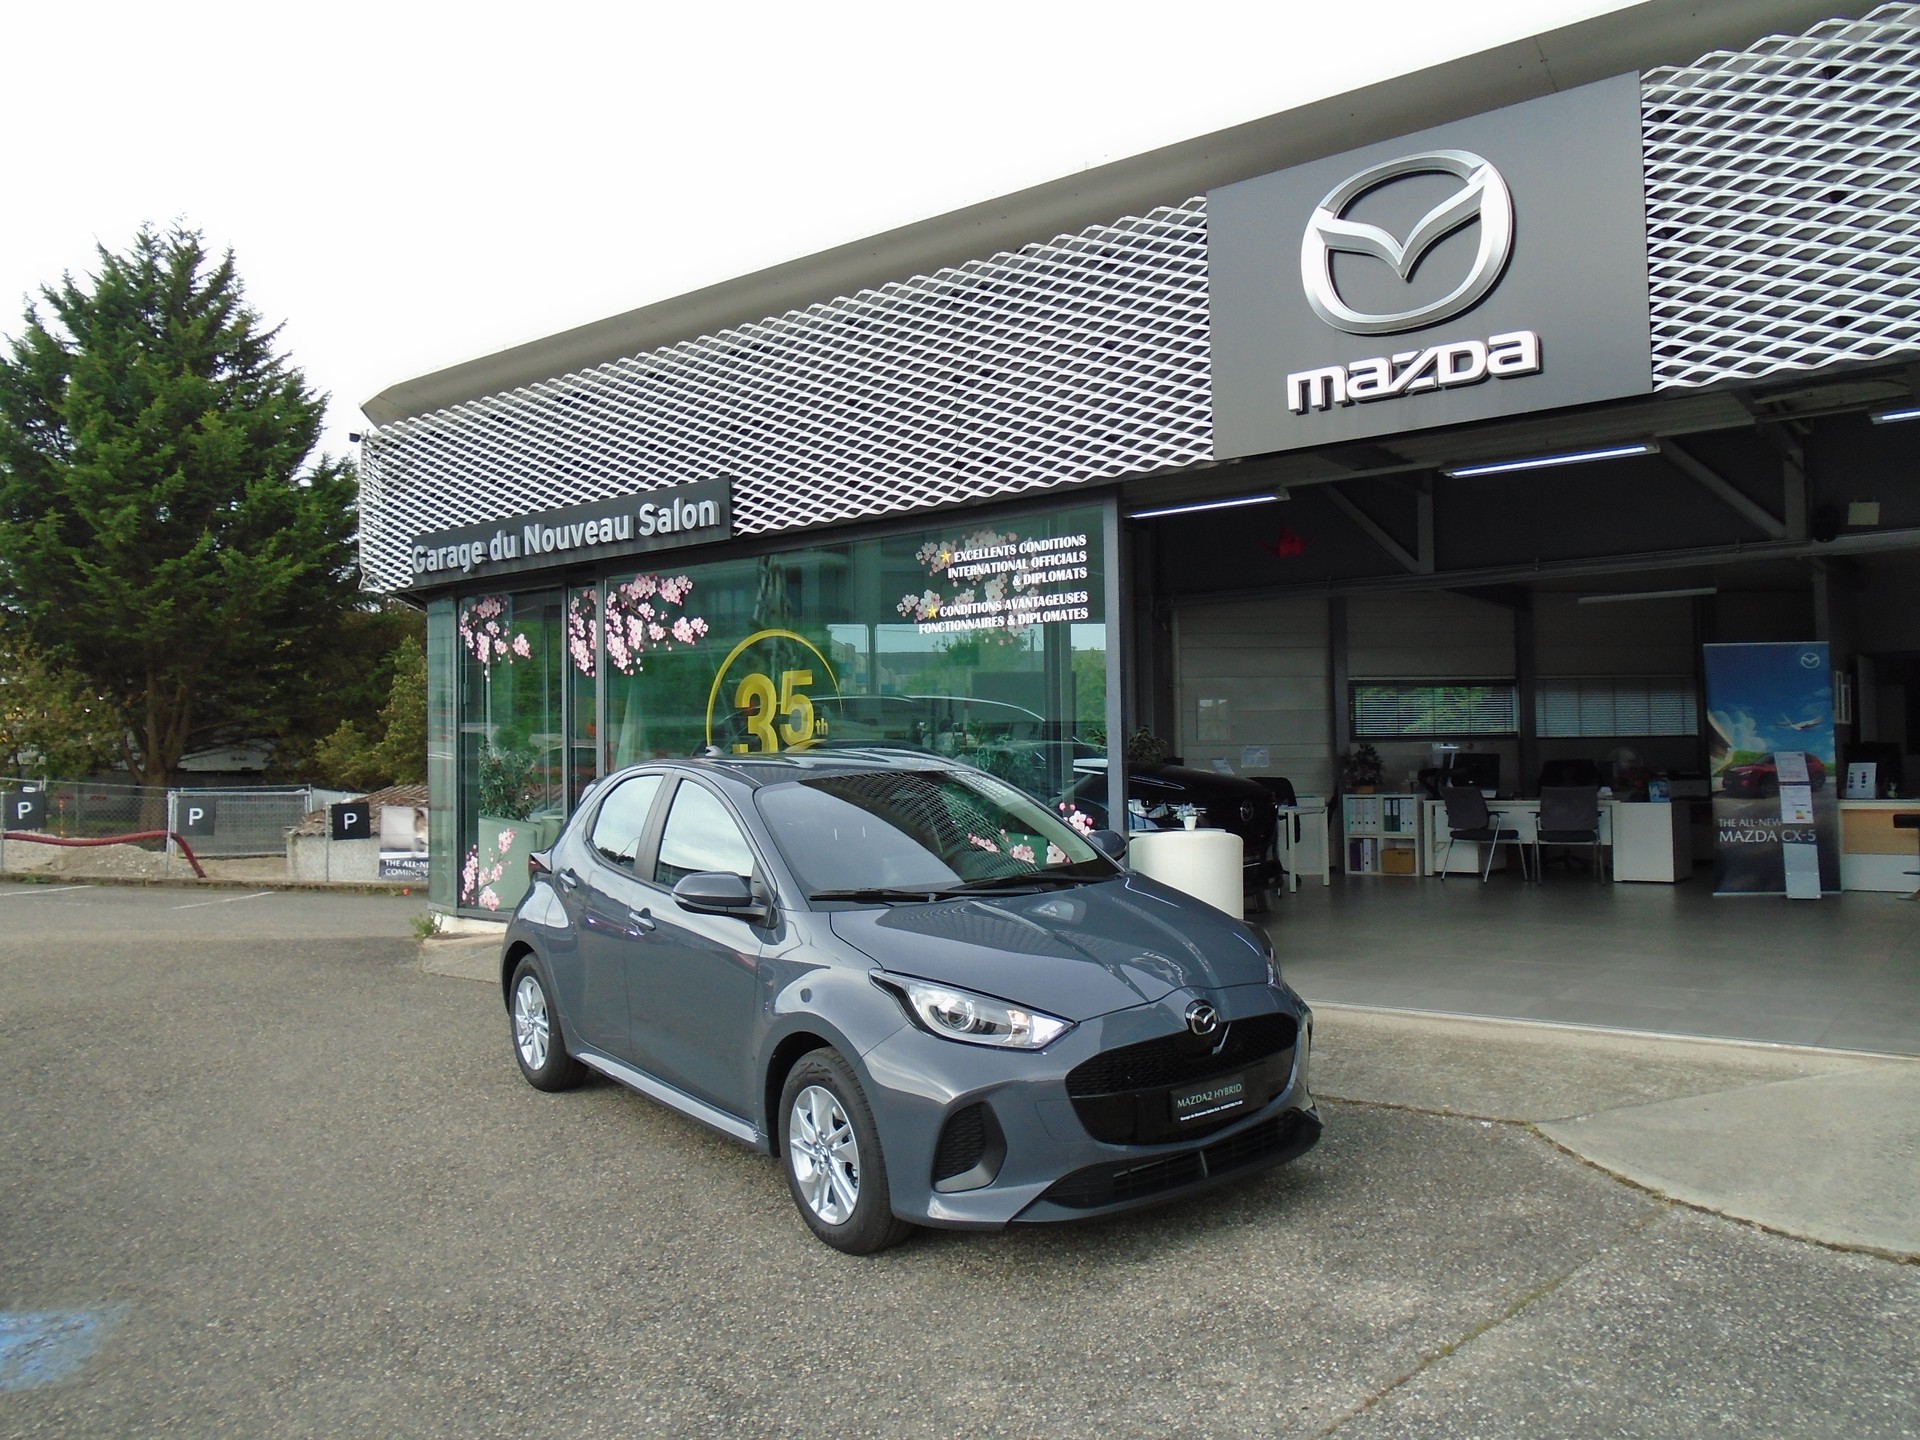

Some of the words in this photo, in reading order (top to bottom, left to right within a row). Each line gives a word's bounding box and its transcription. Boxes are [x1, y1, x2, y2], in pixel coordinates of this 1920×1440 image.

[411, 541, 488, 574] Garage
[489, 529, 520, 562] du
[524, 513, 633, 556] Nouveau
[638, 497, 719, 537] Salon
[953, 543, 1017, 563] EXCELLENTS
[1018, 534, 1087, 555] CONDITIONS
[947, 558, 1029, 579] INTERNATIONAL
[1030, 550, 1088, 569] OFFICIALS
[1012, 574, 1021, 587] &
[1023, 566, 1088, 586] DIPLOMATS
[939, 600, 1003, 618] CONDITIONS
[1004, 591, 1089, 611] AVANTAGEUSES
[918, 615, 1005, 635] FONCTIONNAIRES
[1006, 614, 1016, 626] &
[1017, 607, 1089, 625] DIPLOMATES
[17, 801, 33, 820] P
[188, 807, 204, 827] P
[343, 812, 358, 830] P
[1718, 818, 1737, 828] THE
[1738, 817, 1782, 828] ALL-NEW
[1718, 830, 1778, 843] MAZDA
[1781, 829, 1816, 842] CX-5
[384, 868, 421, 877] COMING
[1177, 1091, 1213, 1108] MAZDA2
[1214, 1083, 1242, 1099] HYBRID
